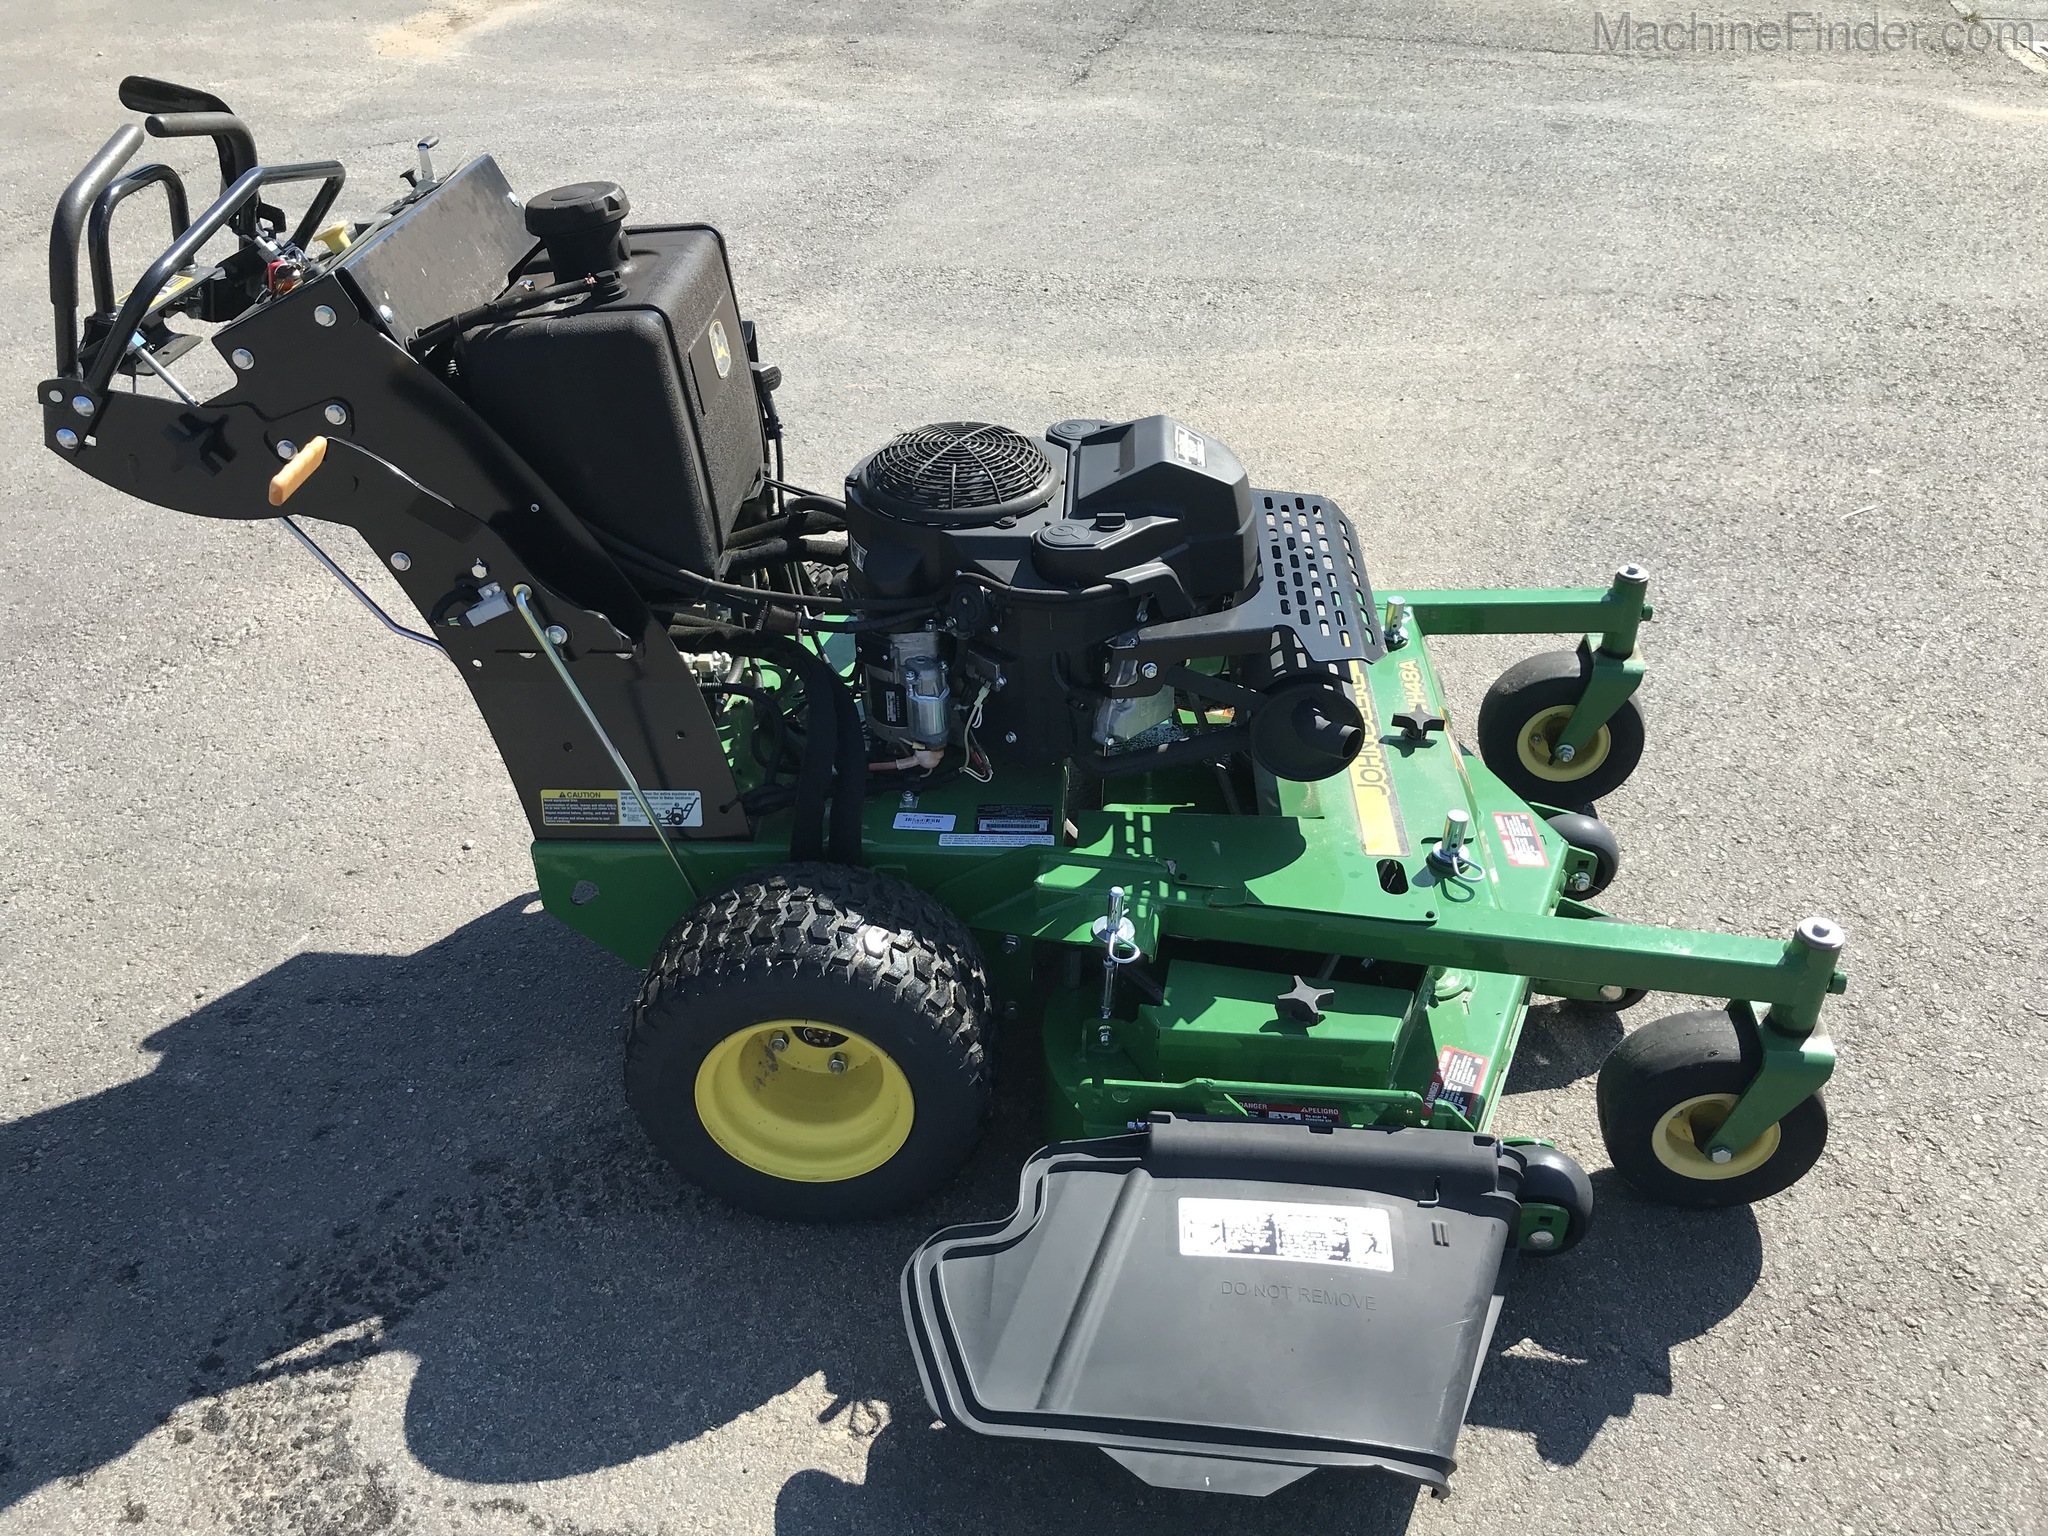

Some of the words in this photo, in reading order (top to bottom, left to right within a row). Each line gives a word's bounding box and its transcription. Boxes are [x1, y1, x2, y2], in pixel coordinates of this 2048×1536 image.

[1357, 741, 1388, 796] JOHN
[566, 791, 601, 799] CAUTION
[1426, 1081, 1440, 1101] DANGER
[1308, 1107, 1339, 1115] PELIGRO
[1221, 1280, 1247, 1296] DO
[1254, 1283, 1293, 1300] NOT
[1299, 1286, 1377, 1311] REMOVE
